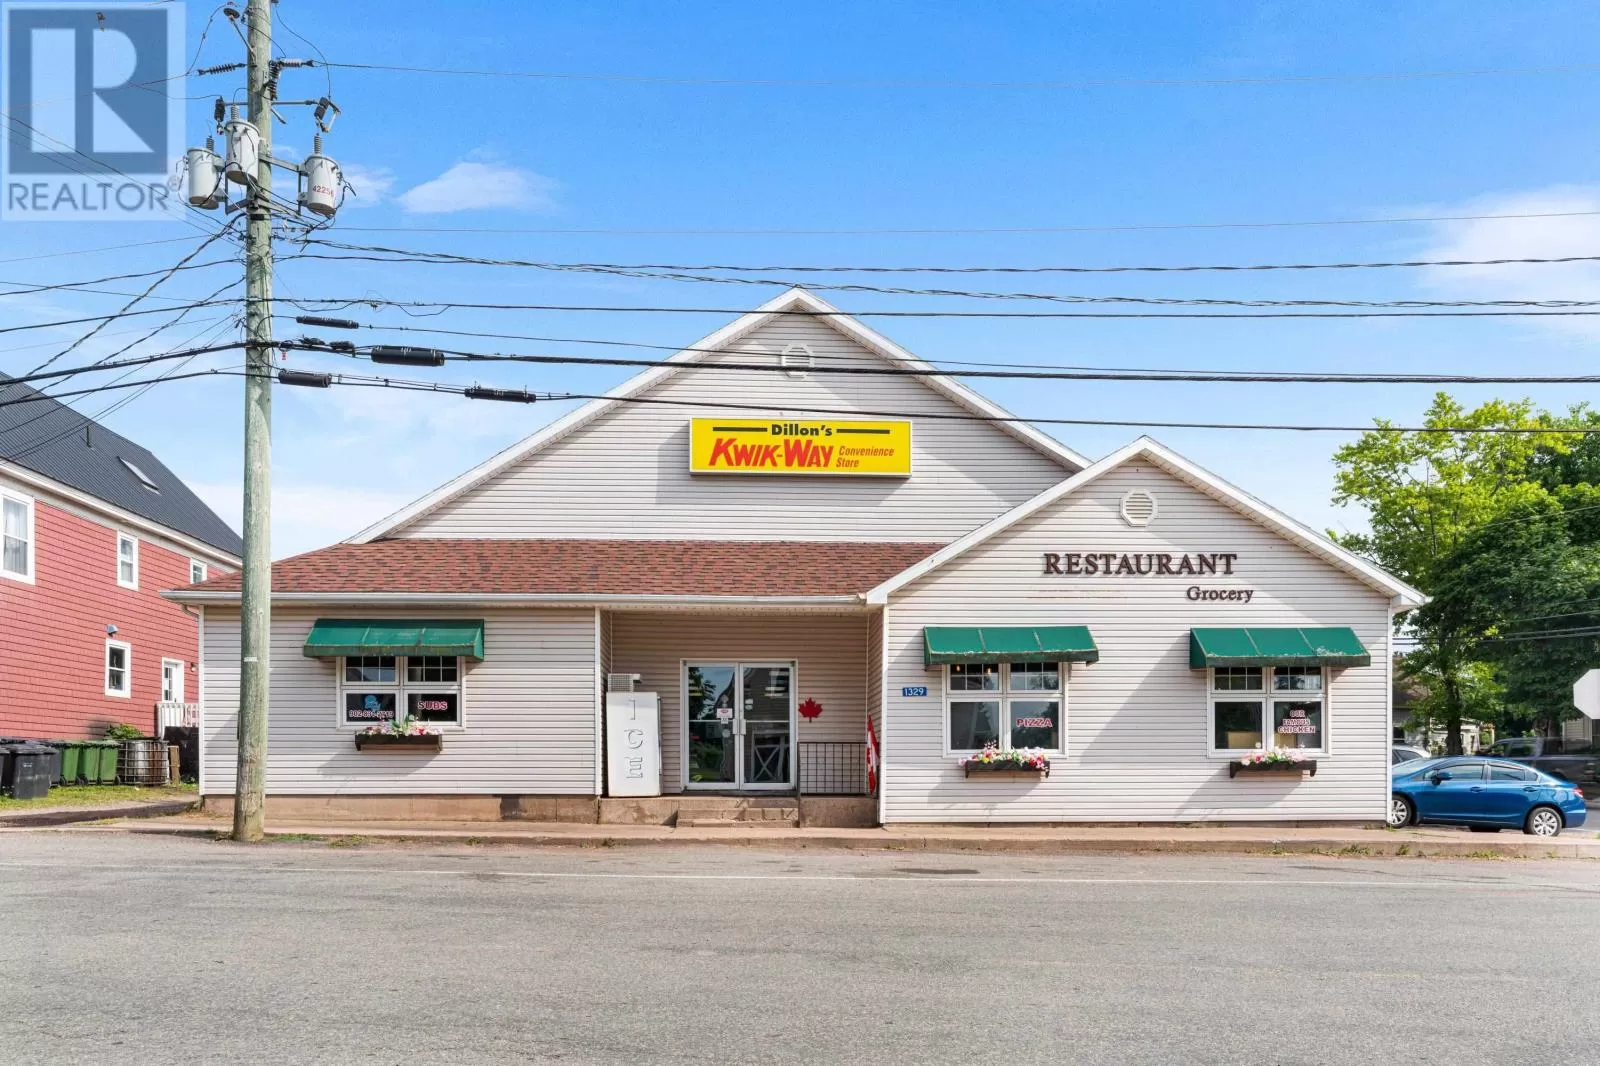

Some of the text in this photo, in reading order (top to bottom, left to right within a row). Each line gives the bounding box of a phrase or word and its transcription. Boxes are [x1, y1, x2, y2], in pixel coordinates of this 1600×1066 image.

[771, 424, 832, 436] Dillon's
[838, 446, 894, 457] Convenience
[836, 457, 859, 468] Store
[1044, 553, 1238, 575] RESTAURANT
[1186, 586, 1254, 603] Grocery
[904, 687, 924, 696] 1329
[417, 701, 448, 710] SUBS
[1290, 709, 1305, 717] OUR
[1016, 718, 1053, 728] PIZZA
[1278, 726, 1316, 734] CHICKEN
[624, 699, 644, 779] ICE
